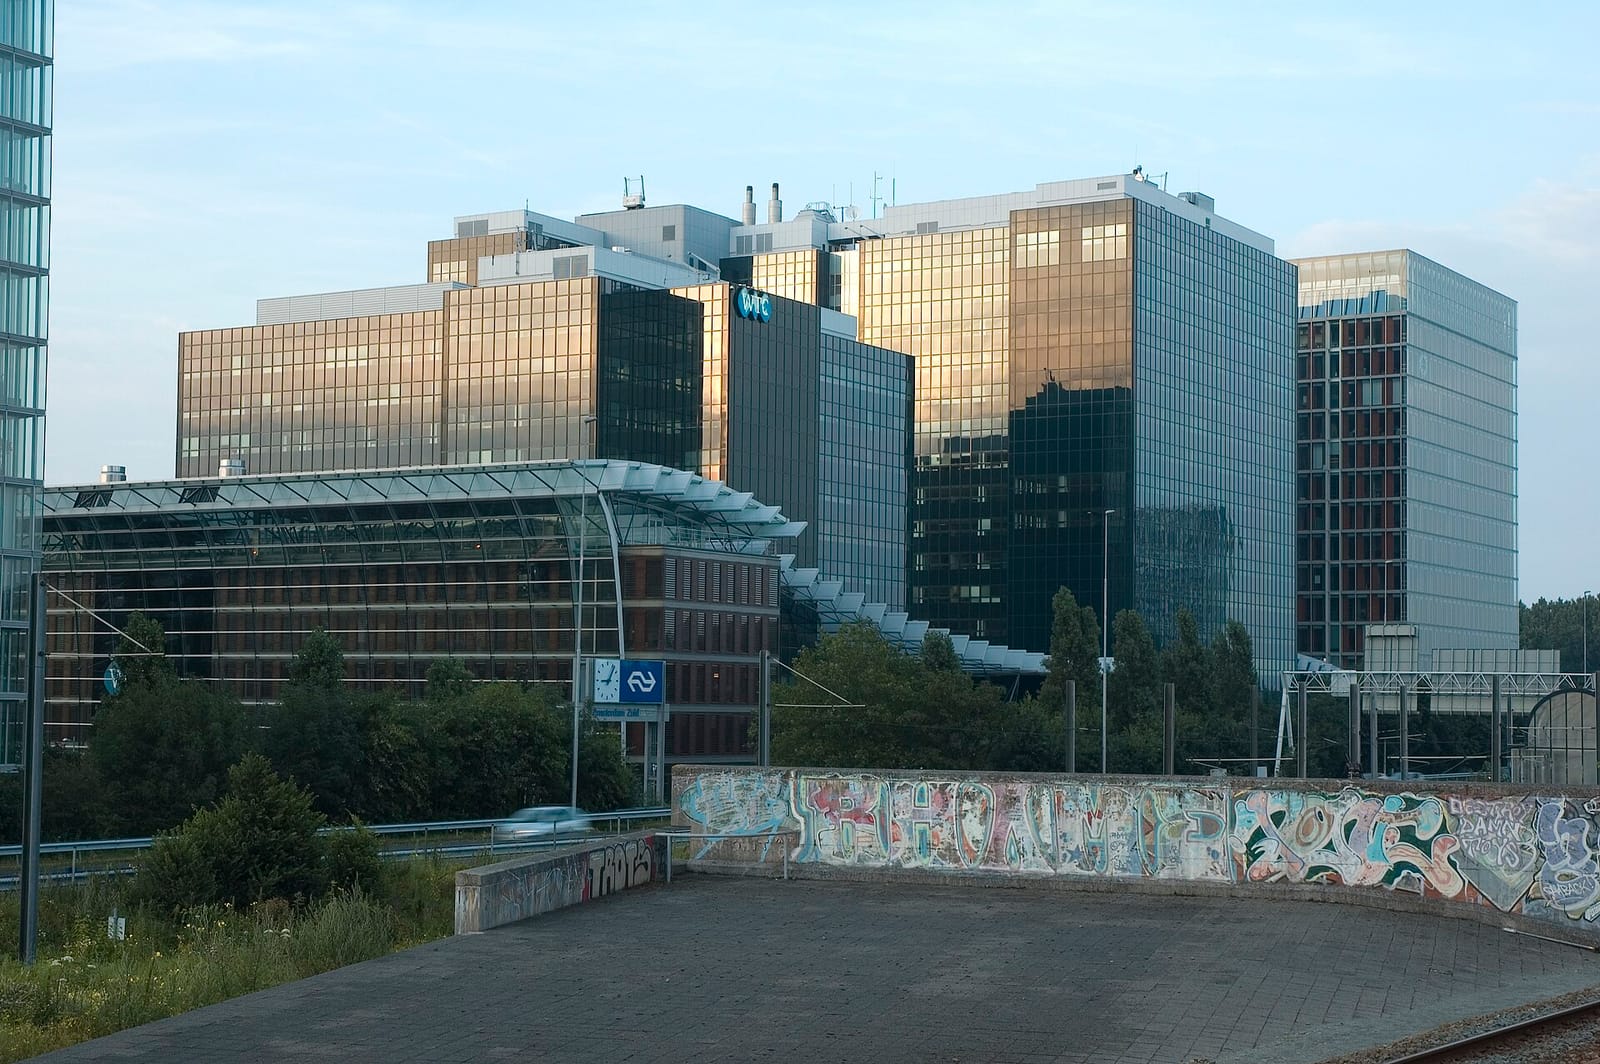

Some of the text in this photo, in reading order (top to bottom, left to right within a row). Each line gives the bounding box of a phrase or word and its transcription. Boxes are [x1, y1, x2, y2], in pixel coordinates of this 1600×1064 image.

[740, 291, 770, 317] WTC
[1460, 817, 1521, 842] DAMN
[1462, 839, 1520, 868] TOYS
